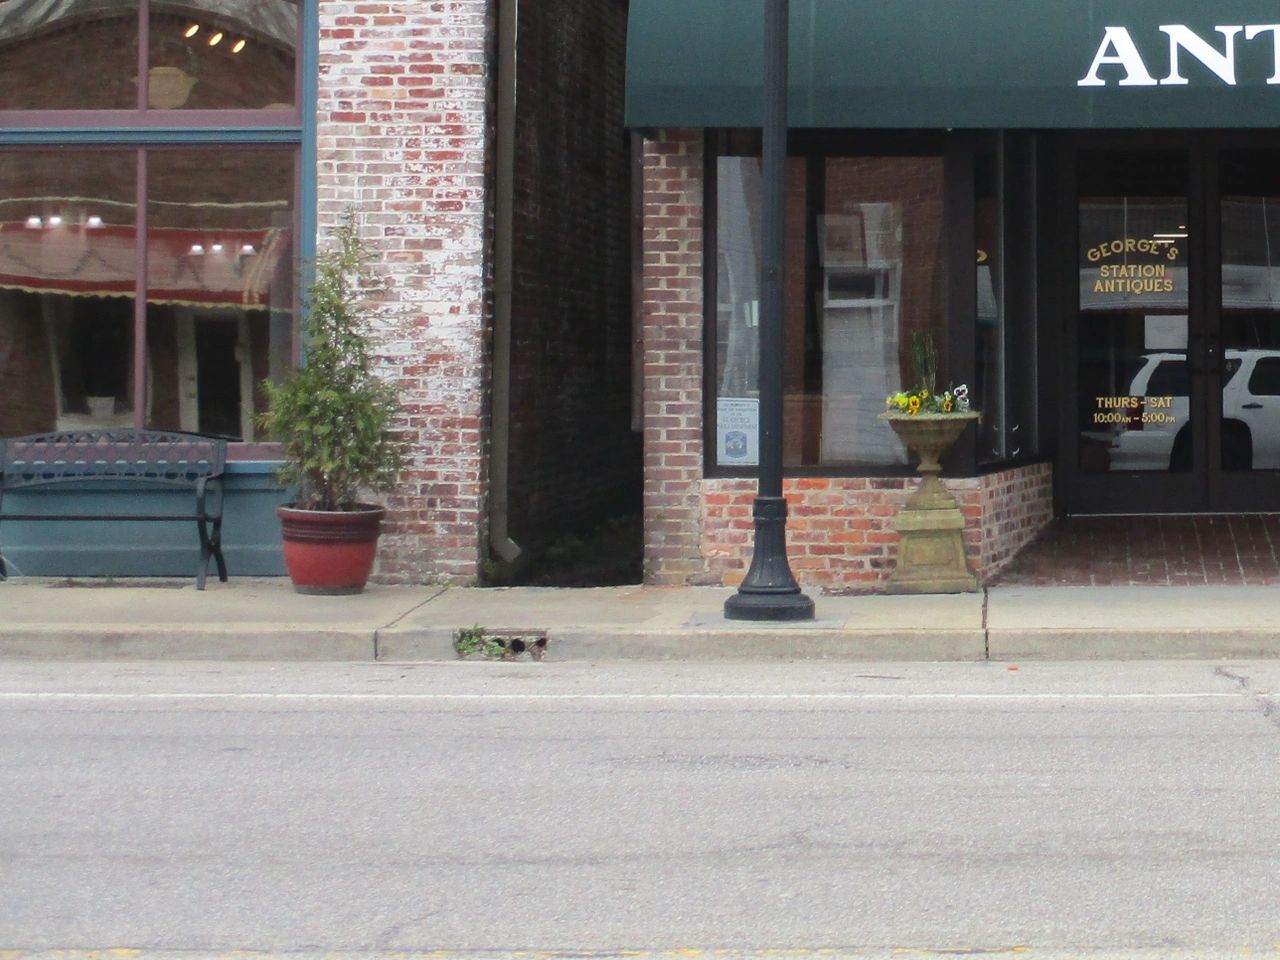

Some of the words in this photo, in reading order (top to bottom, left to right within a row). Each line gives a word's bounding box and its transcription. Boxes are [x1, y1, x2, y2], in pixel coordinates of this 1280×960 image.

[1087, 239, 1179, 261] GEORGE'S
[1100, 264, 1165, 278] STATION
[1094, 279, 1173, 294] ANTIQUES
[1096, 397, 1138, 408] THURS
[1150, 397, 1172, 408] SAT
